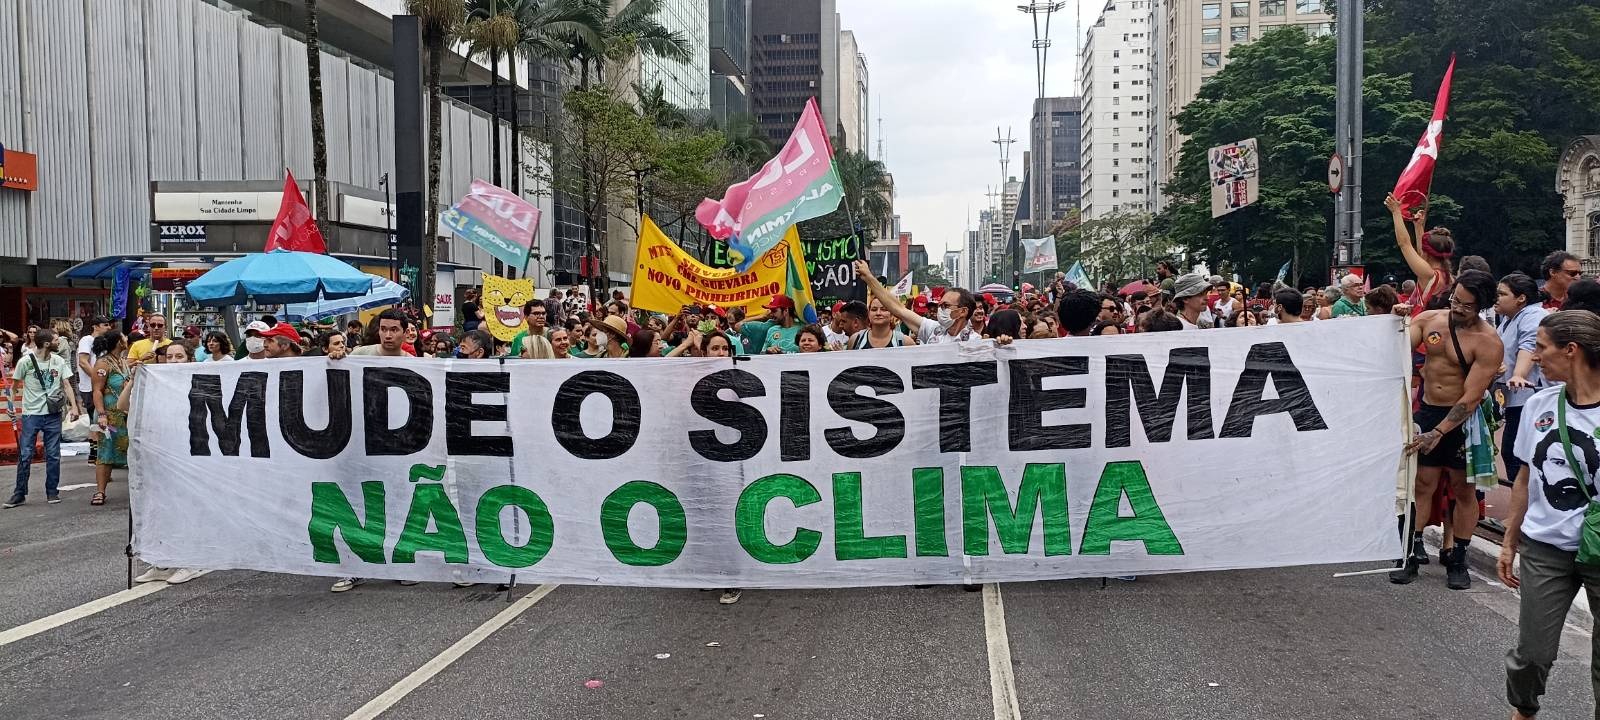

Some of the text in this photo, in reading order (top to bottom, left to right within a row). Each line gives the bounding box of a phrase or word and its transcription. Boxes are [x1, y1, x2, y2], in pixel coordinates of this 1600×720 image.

[237, 207, 257, 215] Limpa
[160, 225, 206, 235] XEROX
[647, 267, 780, 303] NOVO PINHEIRINHO
[700, 271, 759, 290] GUEVARA
[188, 341, 1329, 463] MUDE O SISTEMA
[308, 462, 1183, 568] NÃO O CLIMA
